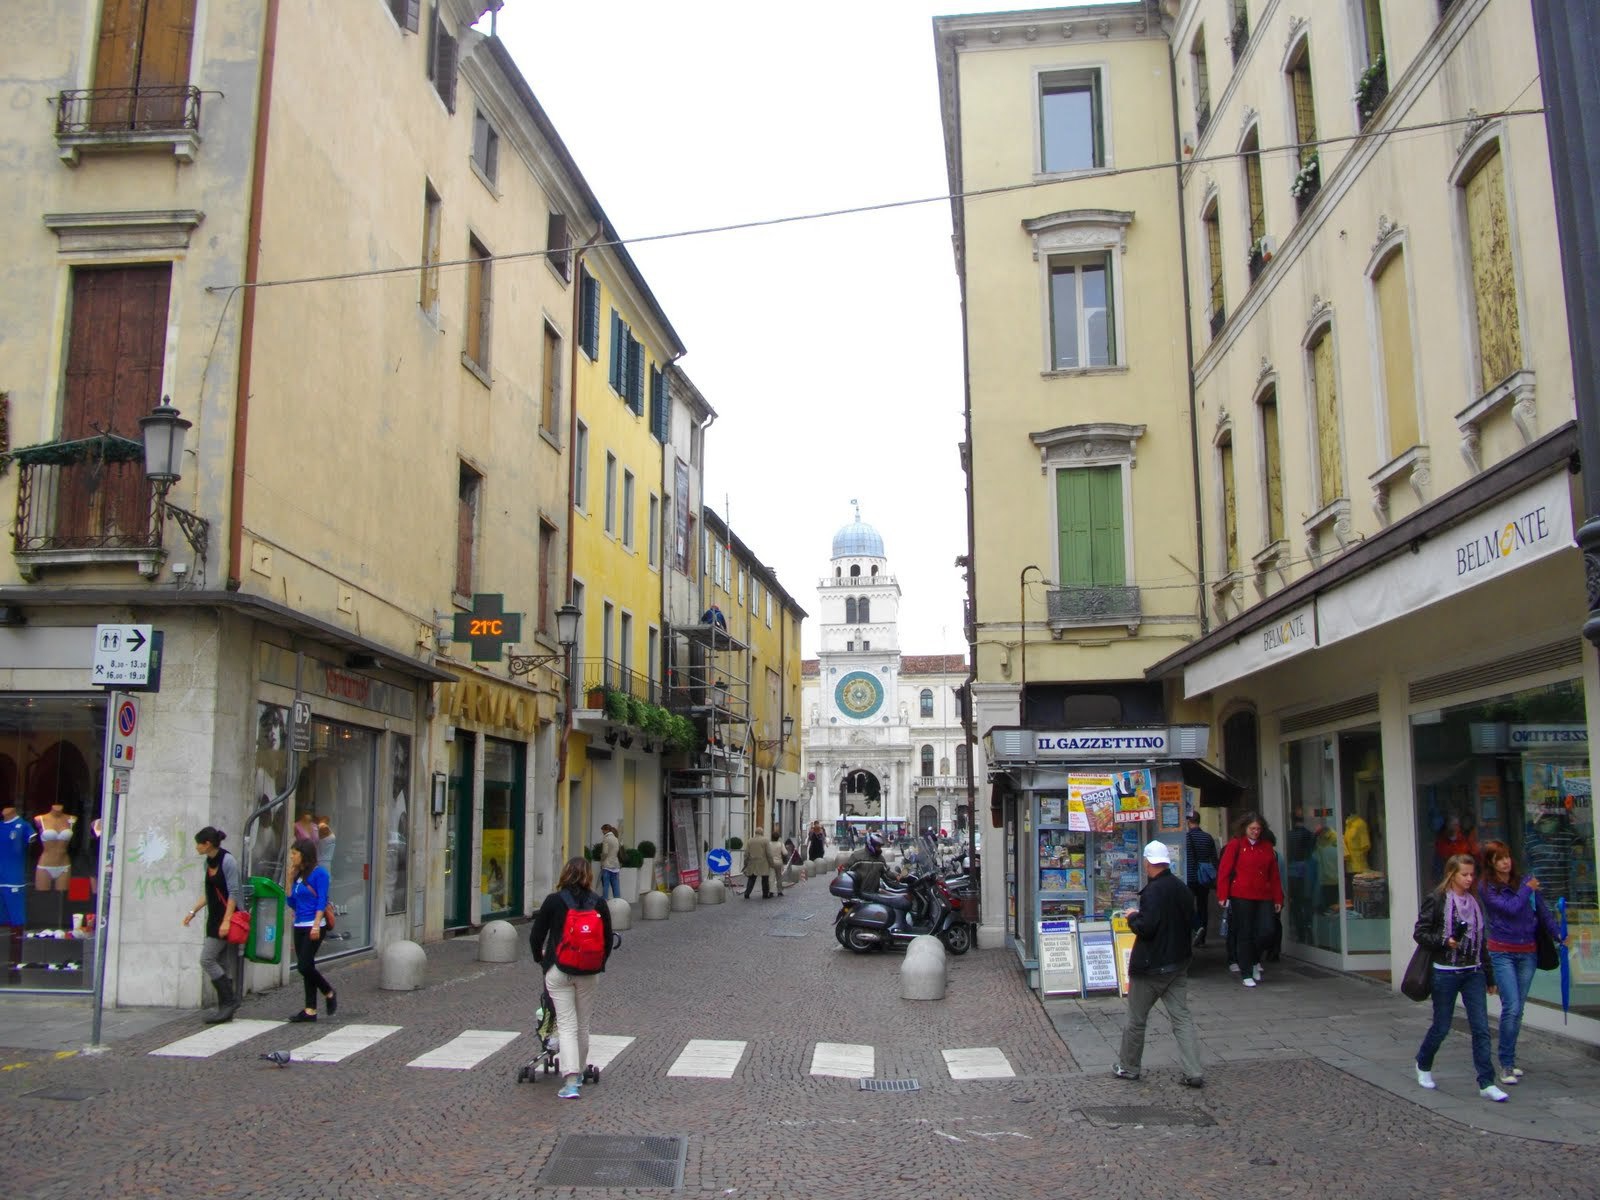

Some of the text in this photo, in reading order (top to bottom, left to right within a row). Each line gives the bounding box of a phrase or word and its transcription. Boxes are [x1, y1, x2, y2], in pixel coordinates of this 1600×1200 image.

[1456, 506, 1549, 576] BELMONTE
[470, 620, 502, 635] 21°C
[1263, 613, 1305, 651] BELMONTE
[1038, 737, 1164, 750] IL GAZZETTINO
